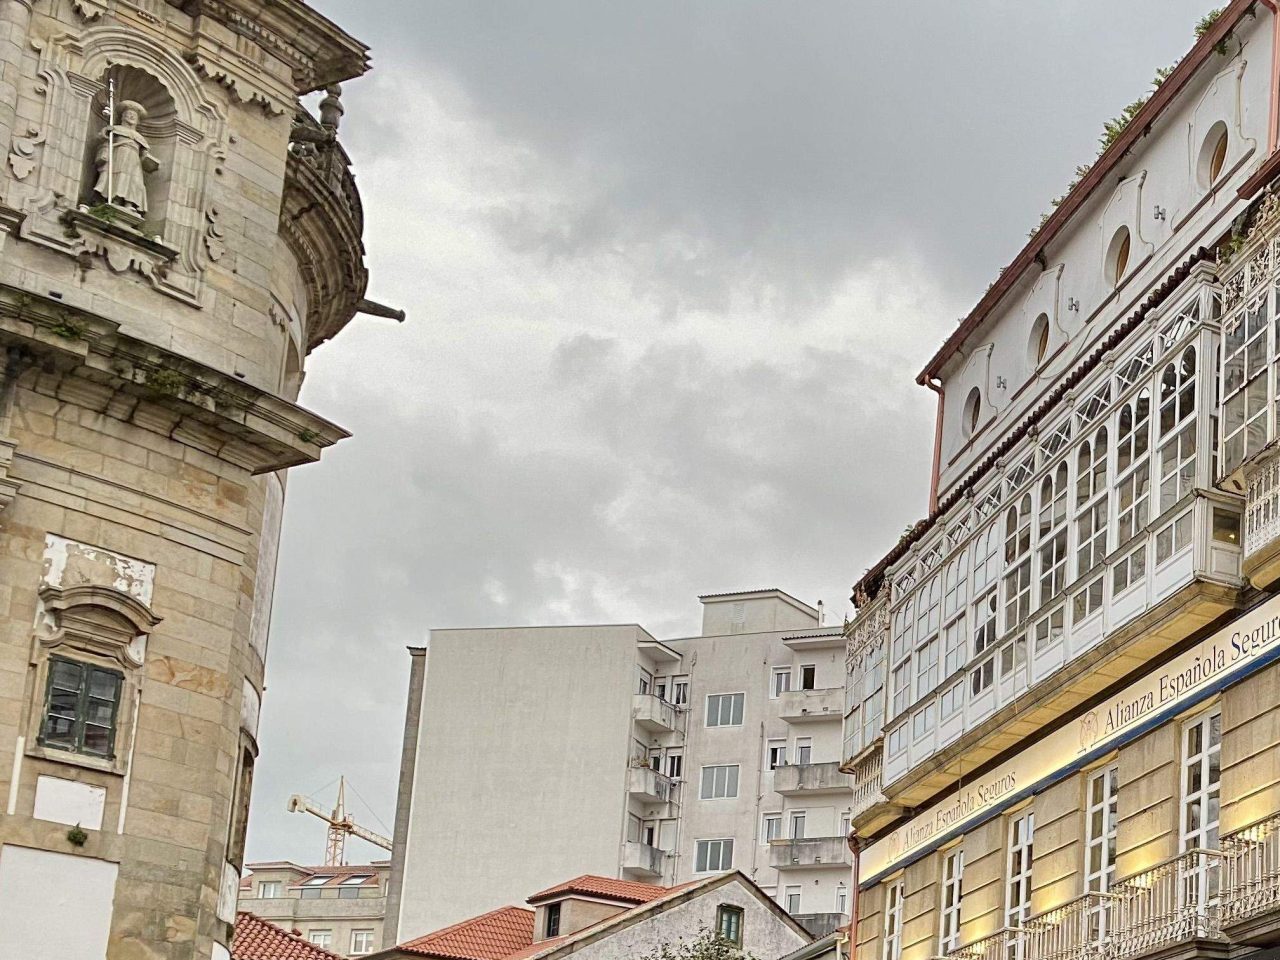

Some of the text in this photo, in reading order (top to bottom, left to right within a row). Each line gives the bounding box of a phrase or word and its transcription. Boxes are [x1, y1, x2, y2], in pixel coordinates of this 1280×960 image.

[1104, 690, 1154, 734] Alianza
[1159, 646, 1226, 702] Española
[903, 820, 934, 851] Alianza
[978, 771, 1016, 806] Seguros
